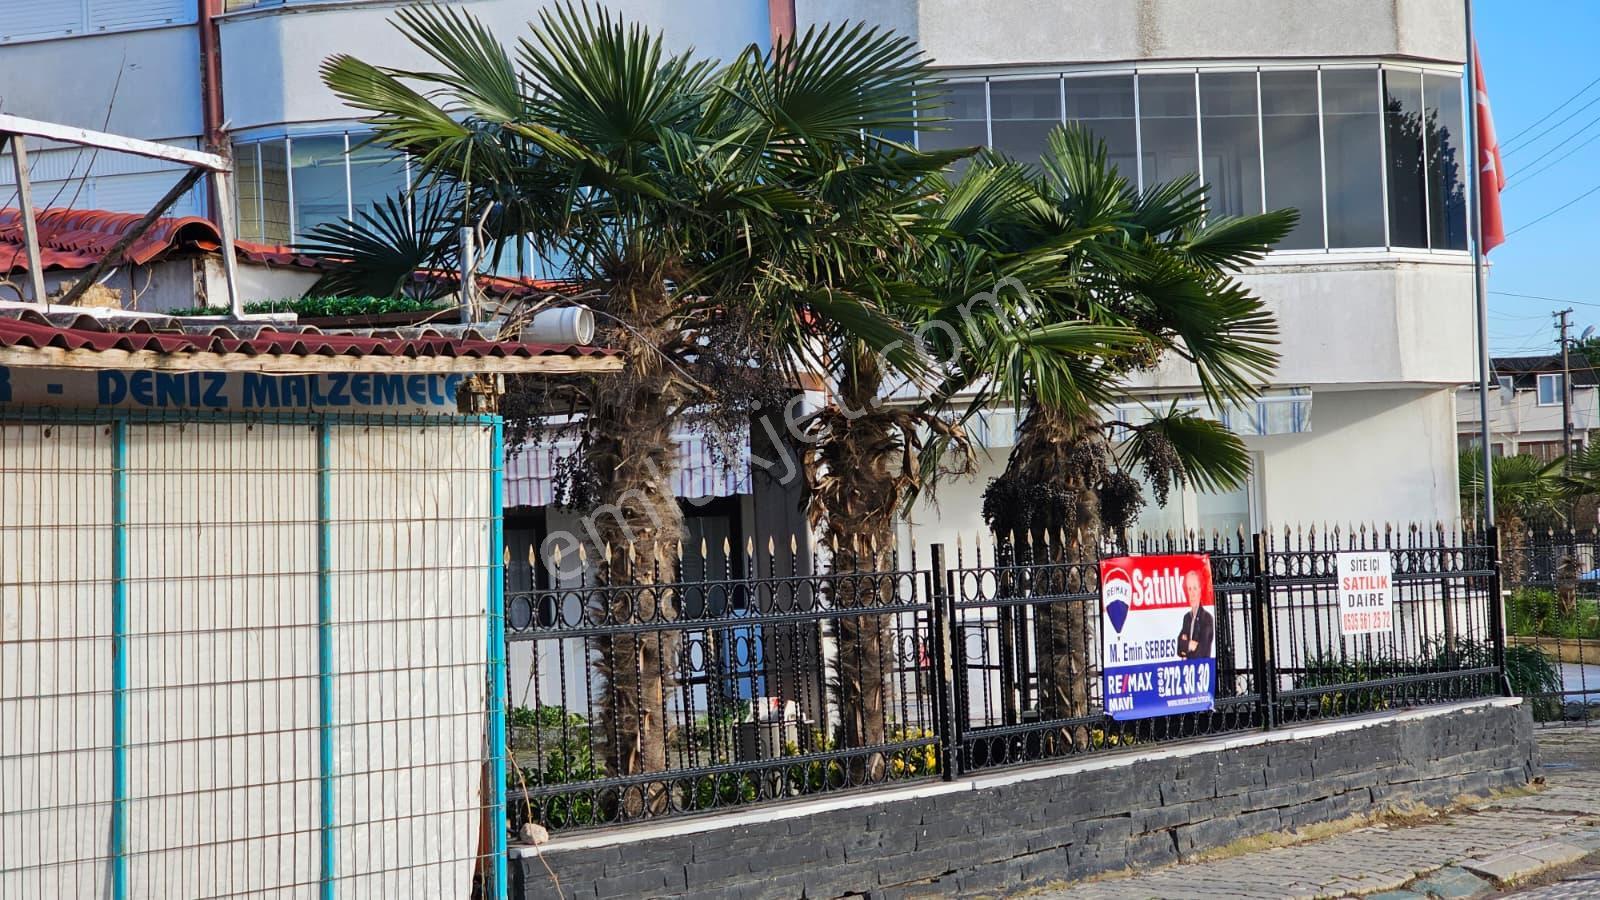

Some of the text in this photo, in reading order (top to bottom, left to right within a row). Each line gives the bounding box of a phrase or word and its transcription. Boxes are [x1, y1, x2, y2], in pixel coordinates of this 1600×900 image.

[242, 370, 470, 408] MALZEMELE
[1132, 567, 1187, 606] Satılık
[1343, 575, 1388, 591] SATILIK
[1109, 644, 1121, 663] M.
[1123, 642, 1143, 662] Emin
[1164, 666, 1182, 697] 272
[1183, 664, 1196, 695] 30
[1197, 662, 1210, 693] 30
